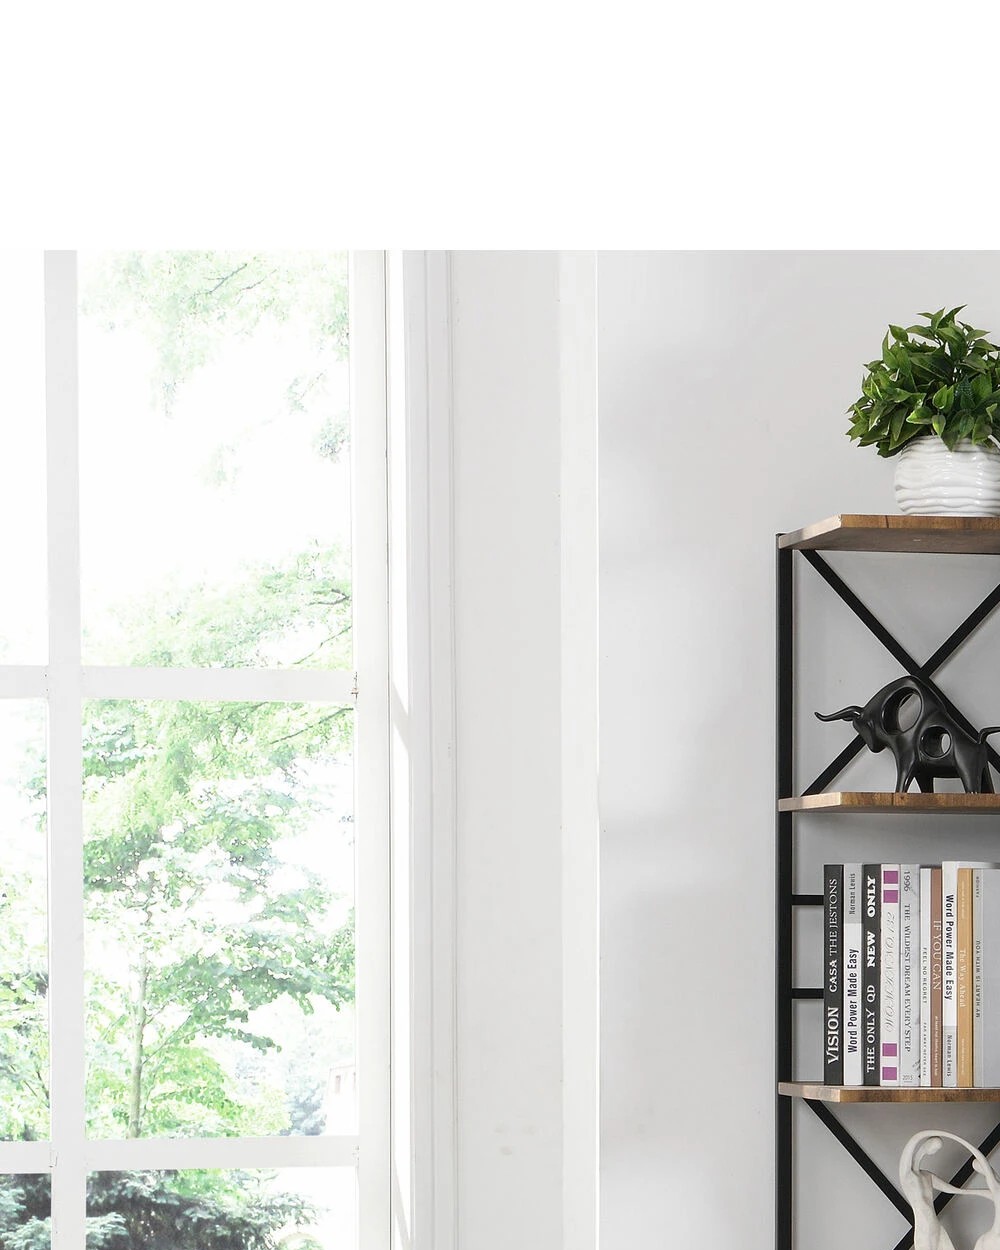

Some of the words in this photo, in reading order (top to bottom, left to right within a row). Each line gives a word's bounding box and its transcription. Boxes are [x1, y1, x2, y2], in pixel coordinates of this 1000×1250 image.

[830, 879, 838, 928] JESTONS
[946, 895, 954, 918] Word
[933, 920, 941, 932] IF
[946, 921, 954, 948] Power
[847, 948, 859, 968] Easy
[932, 934, 941, 961] YOU
[923, 966, 927, 975] NO
[946, 952, 954, 976] Made
[848, 972, 857, 997] Made
[932, 964, 941, 990] CAN
[867, 985, 875, 1002] QD
[944, 980, 954, 1000] Easy
[848, 1000, 857, 1027] Power
[976, 1008, 980, 1017] MY
[826, 1006, 839, 1064] VISION
[866, 1008, 875, 1043] ONLY
[848, 1031, 857, 1053] Word
[867, 1047, 875, 1072] THE
